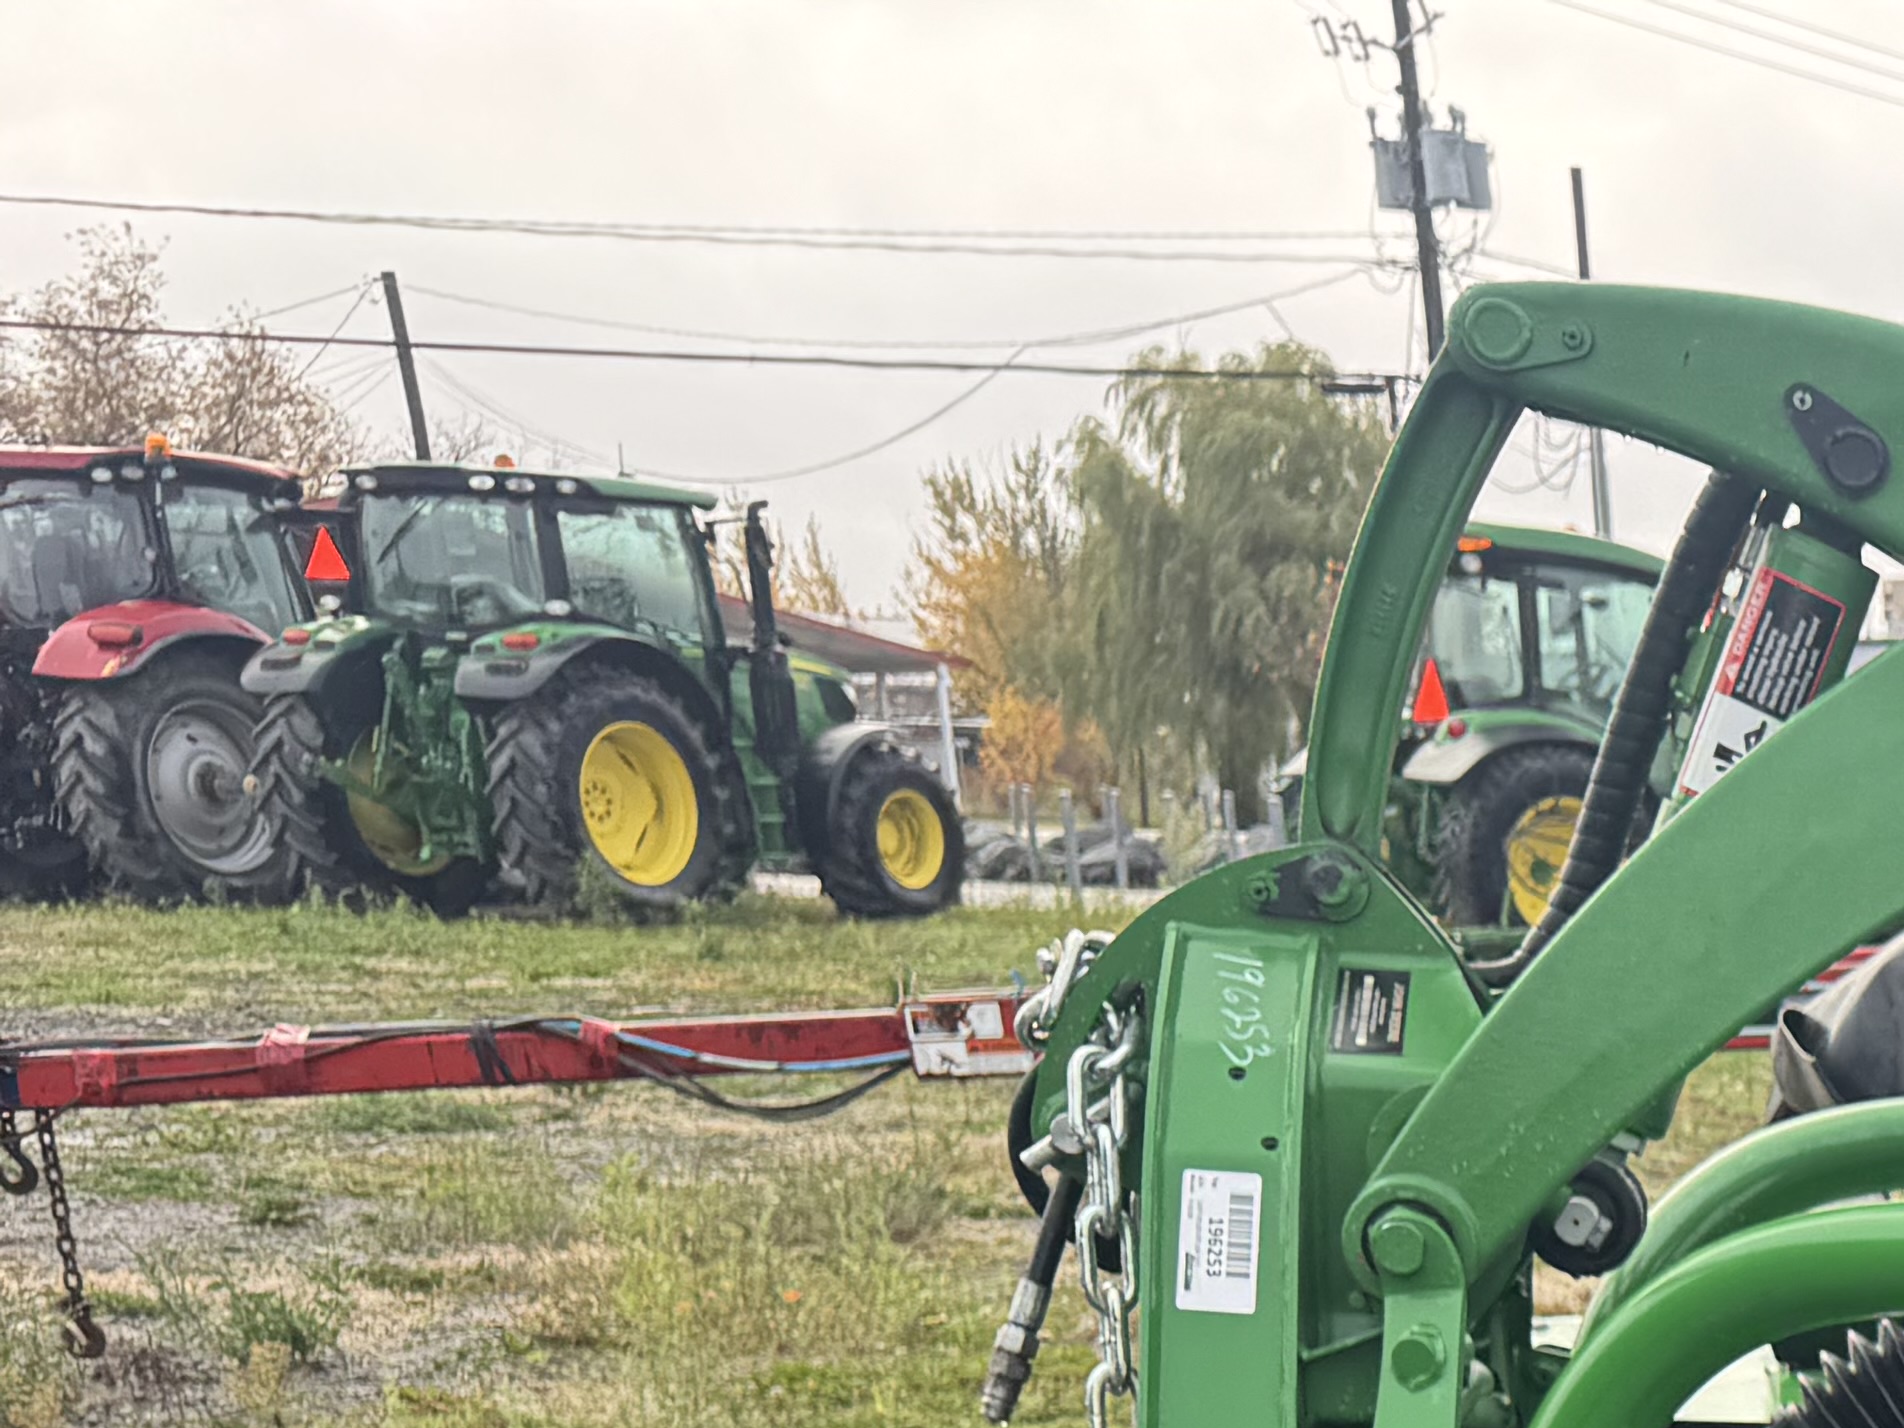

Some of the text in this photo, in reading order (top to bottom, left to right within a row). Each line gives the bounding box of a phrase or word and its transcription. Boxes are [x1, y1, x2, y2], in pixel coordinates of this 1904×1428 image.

[1732, 581, 1765, 656] DANGER
[1213, 952, 1275, 1066] 196253
[1206, 1216, 1225, 1278] 196253
